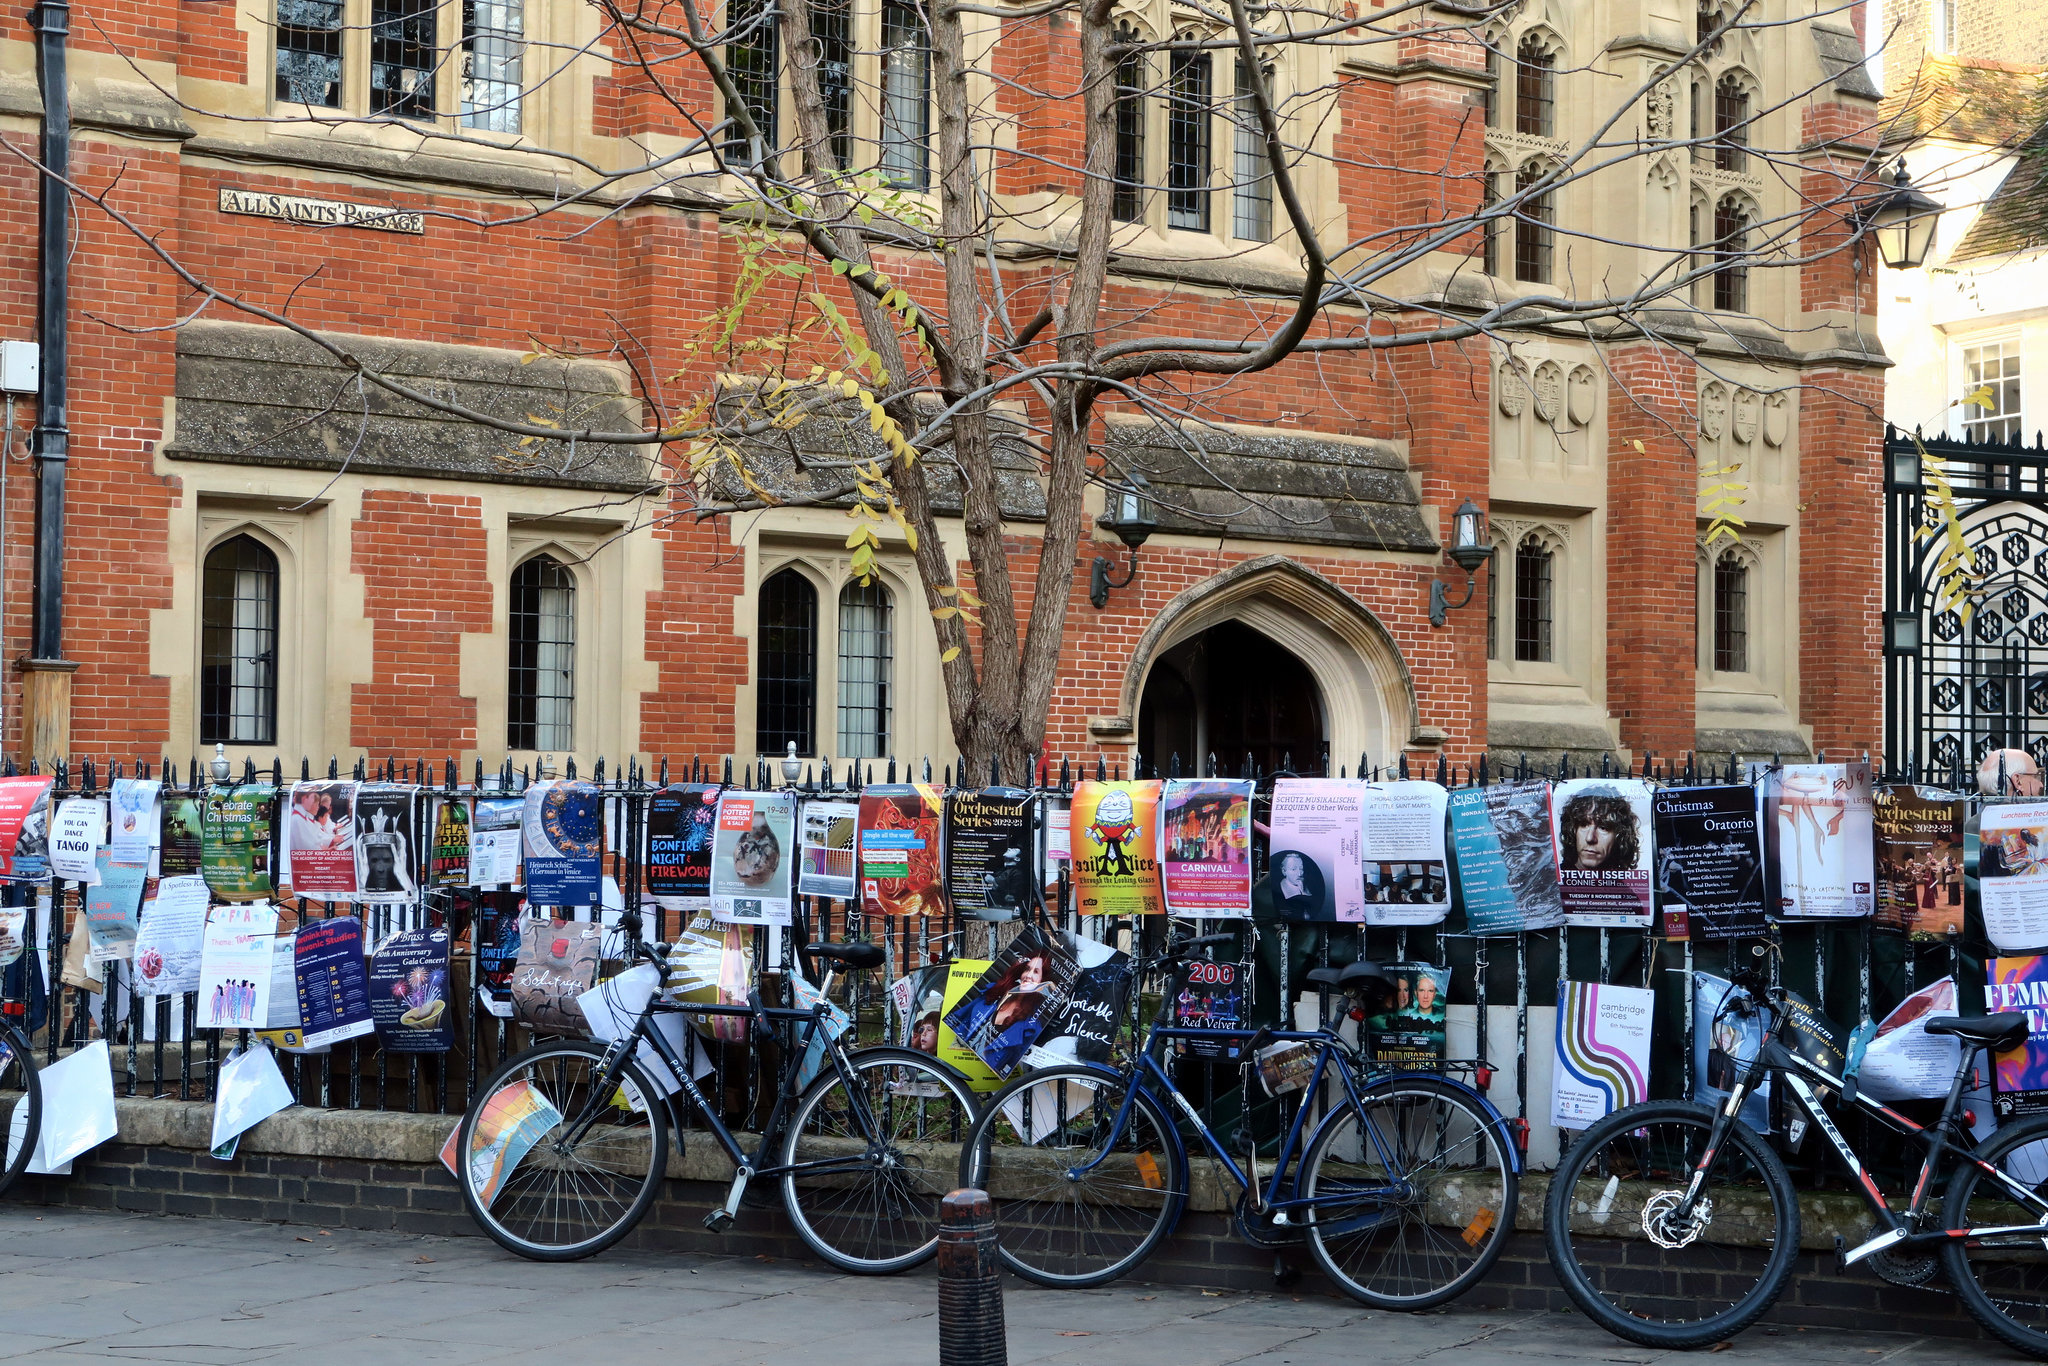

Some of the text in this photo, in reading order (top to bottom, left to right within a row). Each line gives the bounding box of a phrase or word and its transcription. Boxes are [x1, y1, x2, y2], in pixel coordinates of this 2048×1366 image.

[225, 192, 422, 232] ALL SAINTS' PASSAGE
[957, 791, 978, 802] The
[954, 802, 1023, 816] Orchestral
[1656, 800, 1714, 813] Christmas
[953, 814, 1023, 827] Series 2022-23
[1704, 818, 1754, 831] Oratorio
[1914, 824, 1953, 833] 2022-23
[56, 840, 89, 852] TANGO
[651, 840, 700, 852] BONFIRE
[651, 854, 686, 864] NIGHT
[1181, 864, 1232, 872] CARNIVAL!
[1560, 870, 1648, 879] STEVEN ISSERLIS
[168, 880, 192, 890] Spotless
[714, 899, 730, 910] kiln
[88, 912, 126, 920] LANGUAGE
[250, 941, 264, 951] JOY
[296, 932, 357, 954] Slavonic Studies
[391, 949, 432, 957] Anniversary
[1188, 962, 1235, 985] 200
[895, 984, 905, 996] 20
[898, 995, 908, 1005] 27
[1028, 980, 1064, 1026] MIDDLETON
[1601, 1003, 1645, 1016] cambridge
[1601, 1011, 1627, 1020] voices
[1065, 1013, 1112, 1044] Silence
[1181, 1016, 1237, 1030] Red Velvet
[1789, 1020, 1845, 1060] for All Souls' Day
[670, 1059, 706, 1108] PROBIKE
[1805, 1096, 1857, 1161] TREK
